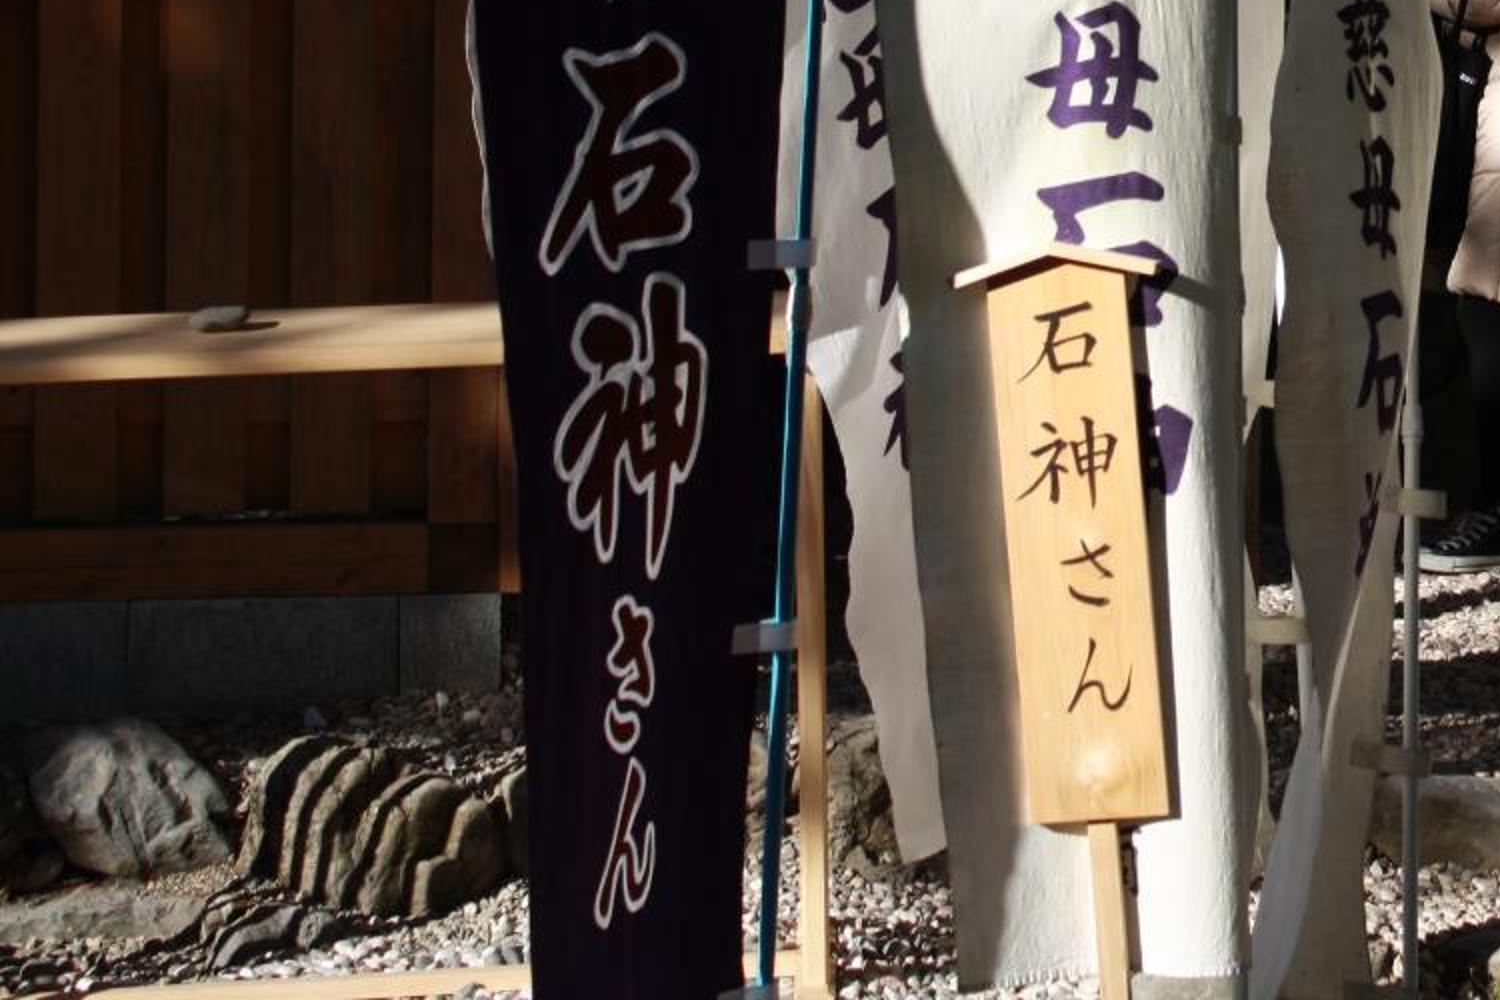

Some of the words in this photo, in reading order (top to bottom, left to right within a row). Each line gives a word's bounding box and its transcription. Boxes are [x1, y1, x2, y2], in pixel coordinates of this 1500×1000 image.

[538, 30, 710, 934] 石神さん
[1017, 301, 1133, 713] 石神さん
